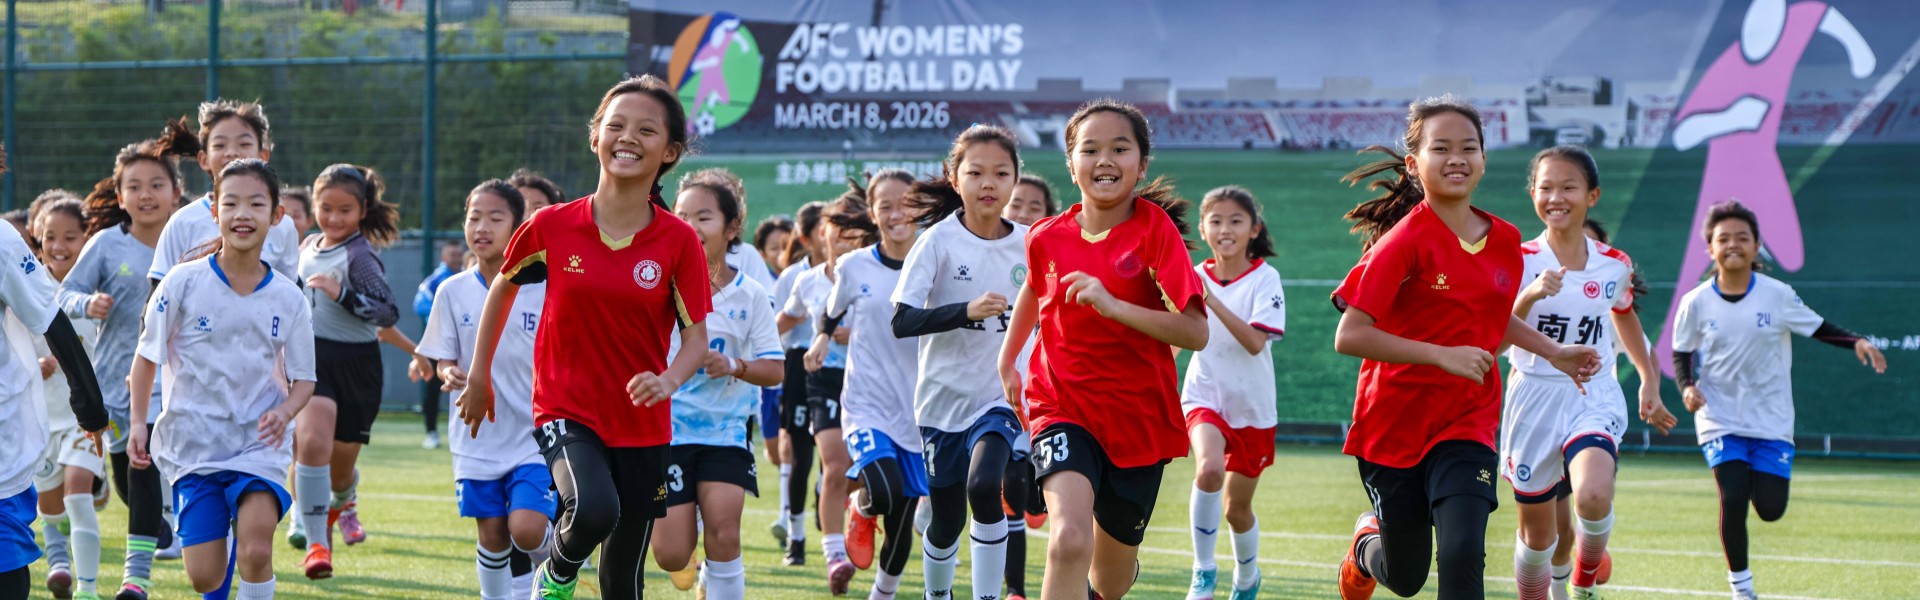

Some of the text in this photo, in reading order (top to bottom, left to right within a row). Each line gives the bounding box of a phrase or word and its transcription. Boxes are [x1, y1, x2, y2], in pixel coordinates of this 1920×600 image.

[779, 24, 850, 59] AFC
[777, 59, 1021, 94] FOOTBALL DAY
[775, 101, 950, 132] MARCH 8, 2026
[563, 266, 585, 274] KELME
[271, 316, 280, 337] 8
[522, 312, 536, 331] 15
[1536, 313, 1603, 345] 南外
[1757, 312, 1771, 328] 24
[794, 404, 808, 427] 5
[826, 399, 838, 419] 7
[1040, 432, 1069, 469] 53
[668, 464, 684, 492] 3
